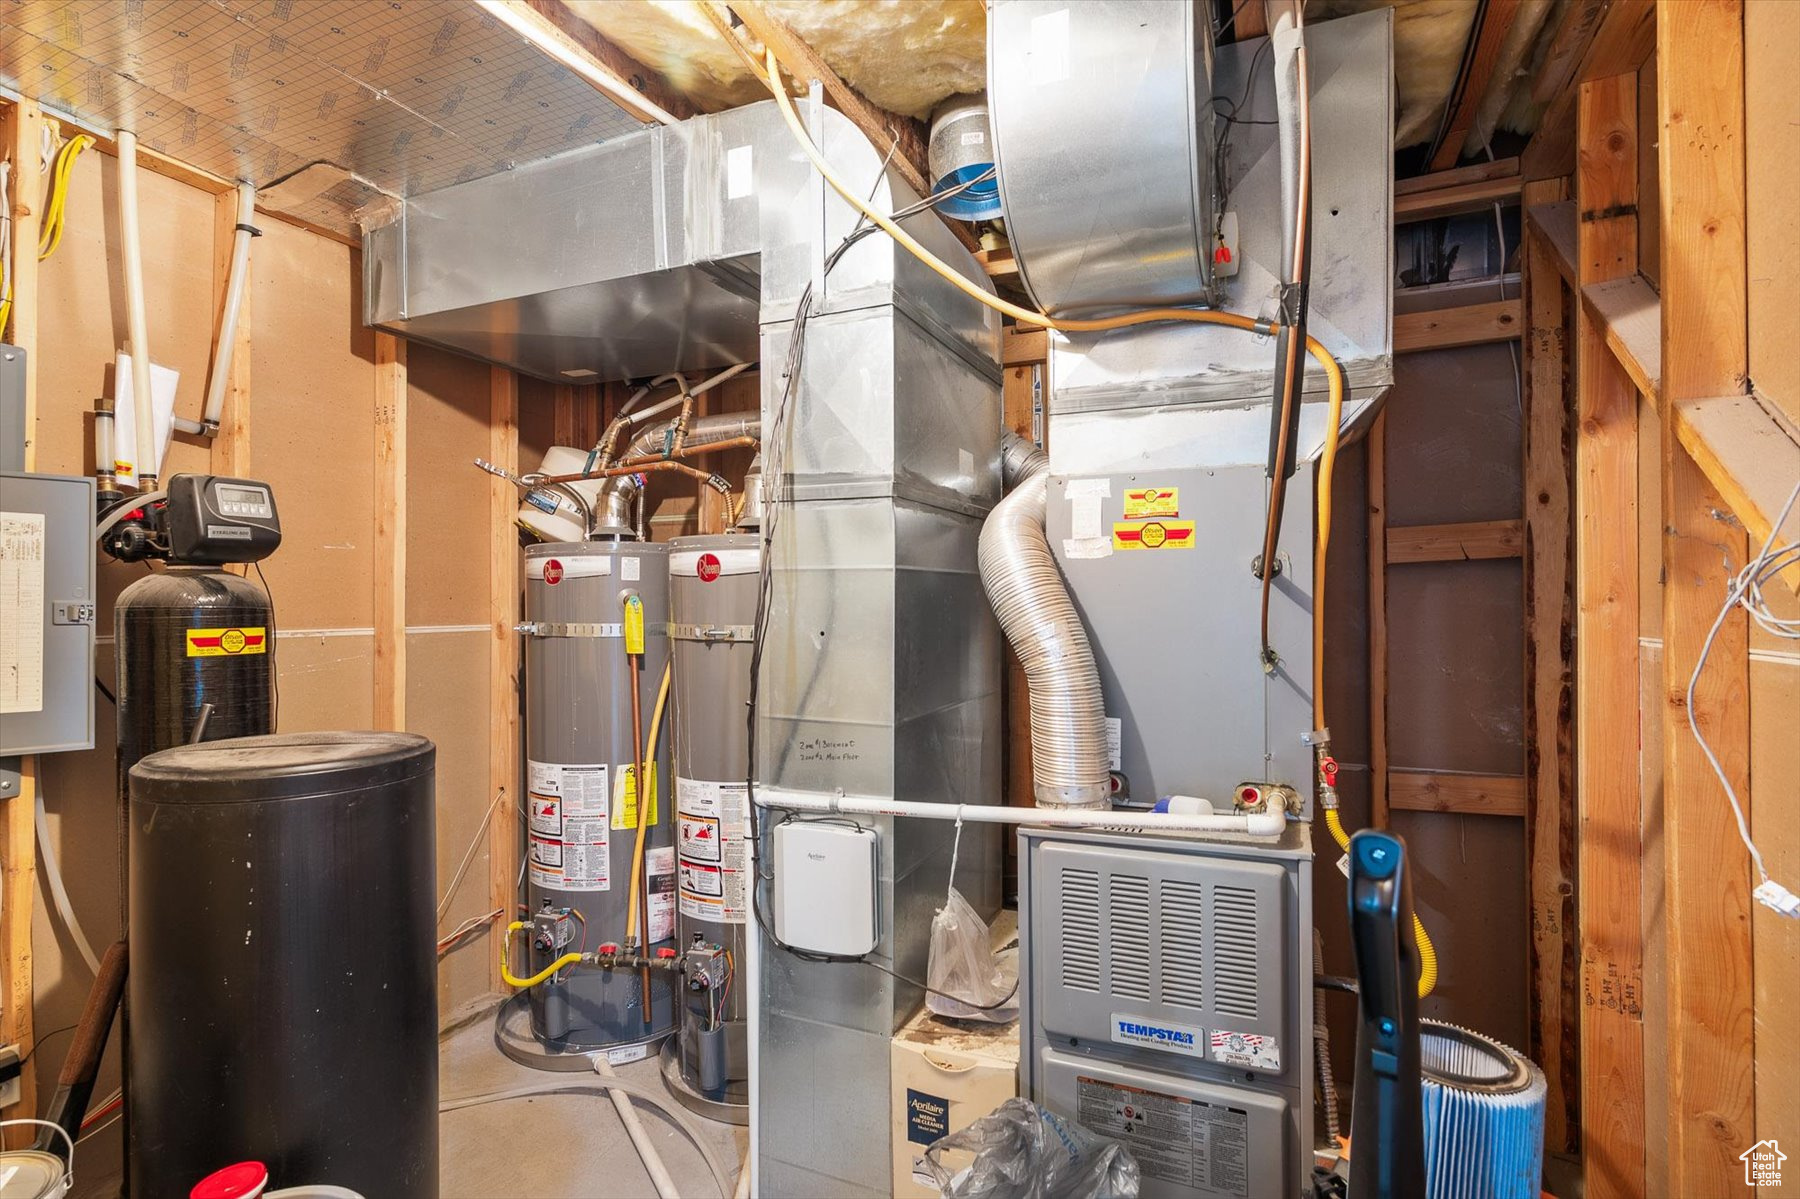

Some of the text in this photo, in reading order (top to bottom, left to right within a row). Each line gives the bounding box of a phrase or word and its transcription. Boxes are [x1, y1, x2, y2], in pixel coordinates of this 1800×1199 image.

[698, 554, 720, 578] Rheem
[1118, 1021, 1194, 1045] TEMPSTAR
[1120, 1033, 1140, 1042] Heating
[1150, 1038, 1171, 1048] Cooling
[1171, 1042, 1194, 1050] Products
[911, 1098, 944, 1115] Aprilaire
[919, 1114, 936, 1122] MEDIA
[921, 1119, 944, 1130] CLEANER
